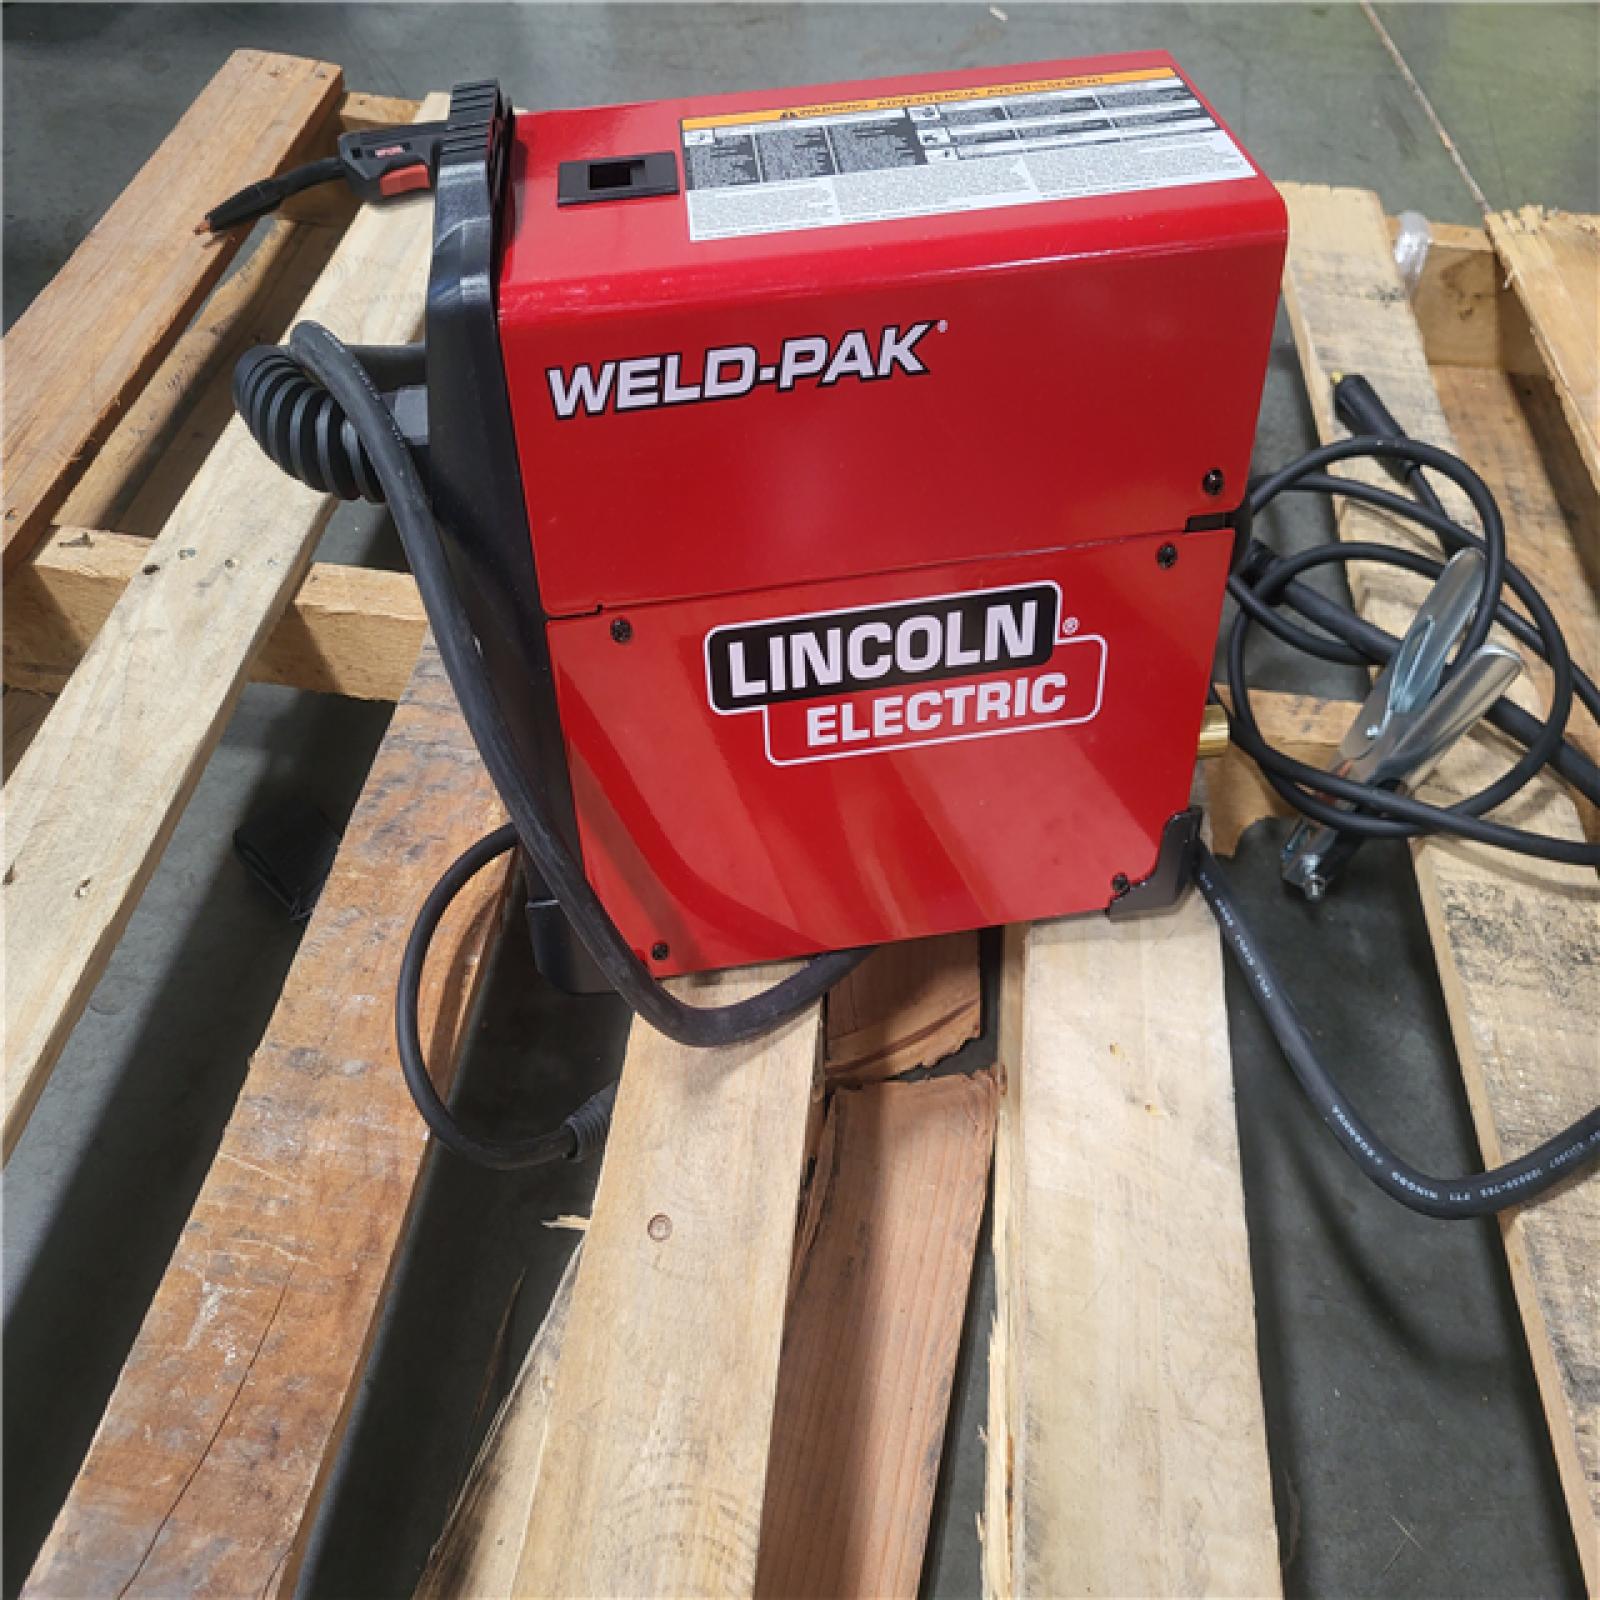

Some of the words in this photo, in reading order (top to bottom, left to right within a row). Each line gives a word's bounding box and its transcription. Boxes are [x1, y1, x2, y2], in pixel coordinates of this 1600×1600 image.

[547, 321, 933, 419] WELD-PAK
[728, 600, 1037, 698] LINCOLN
[806, 673, 1067, 747] ELECTRIC
